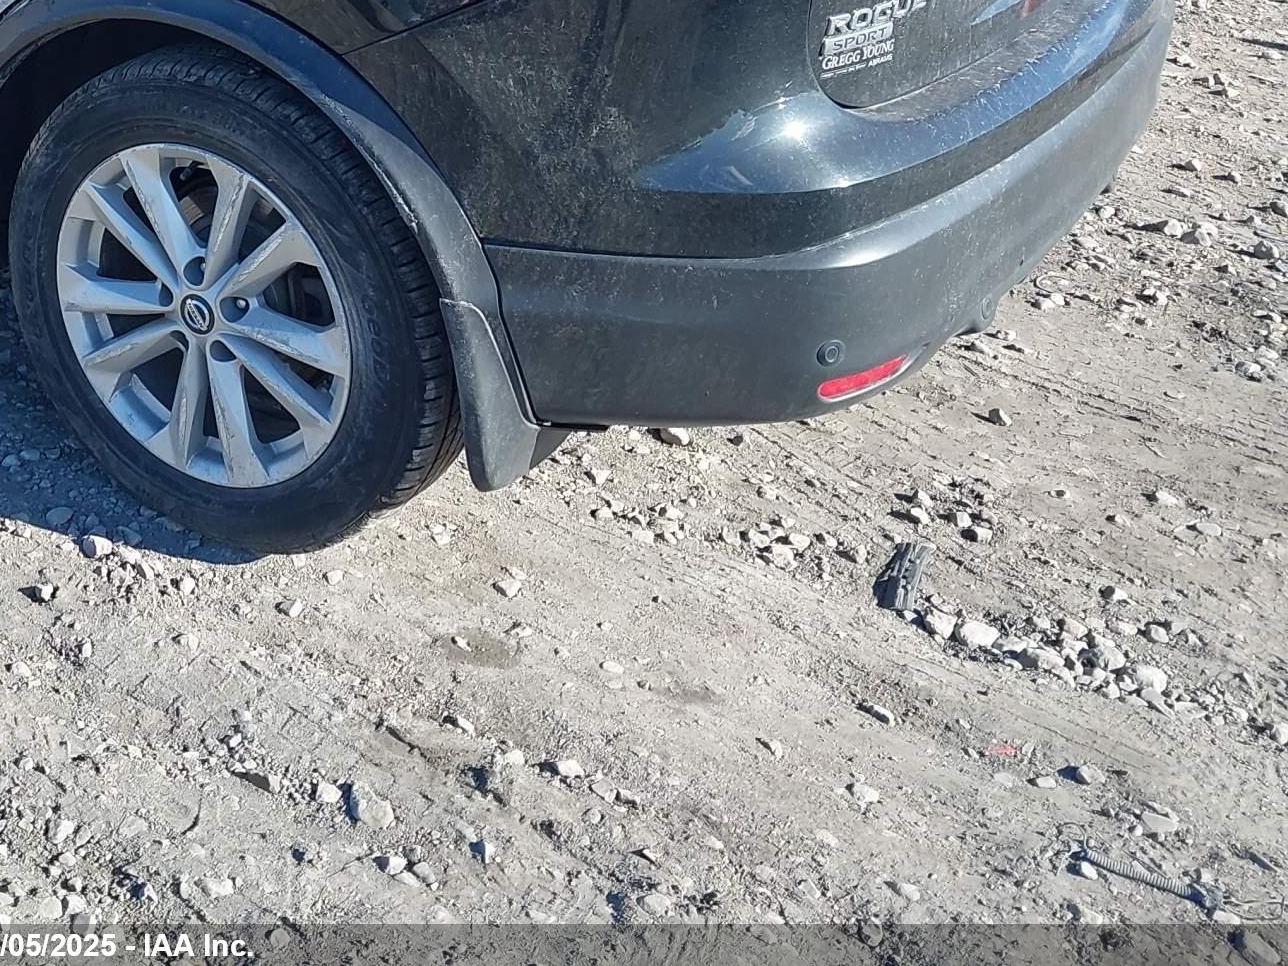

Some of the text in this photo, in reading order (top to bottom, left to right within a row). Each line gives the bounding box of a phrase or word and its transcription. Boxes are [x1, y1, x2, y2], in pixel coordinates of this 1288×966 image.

[832, 26, 888, 51] SPORT
[821, 38, 896, 70] GREGG YOUNG
